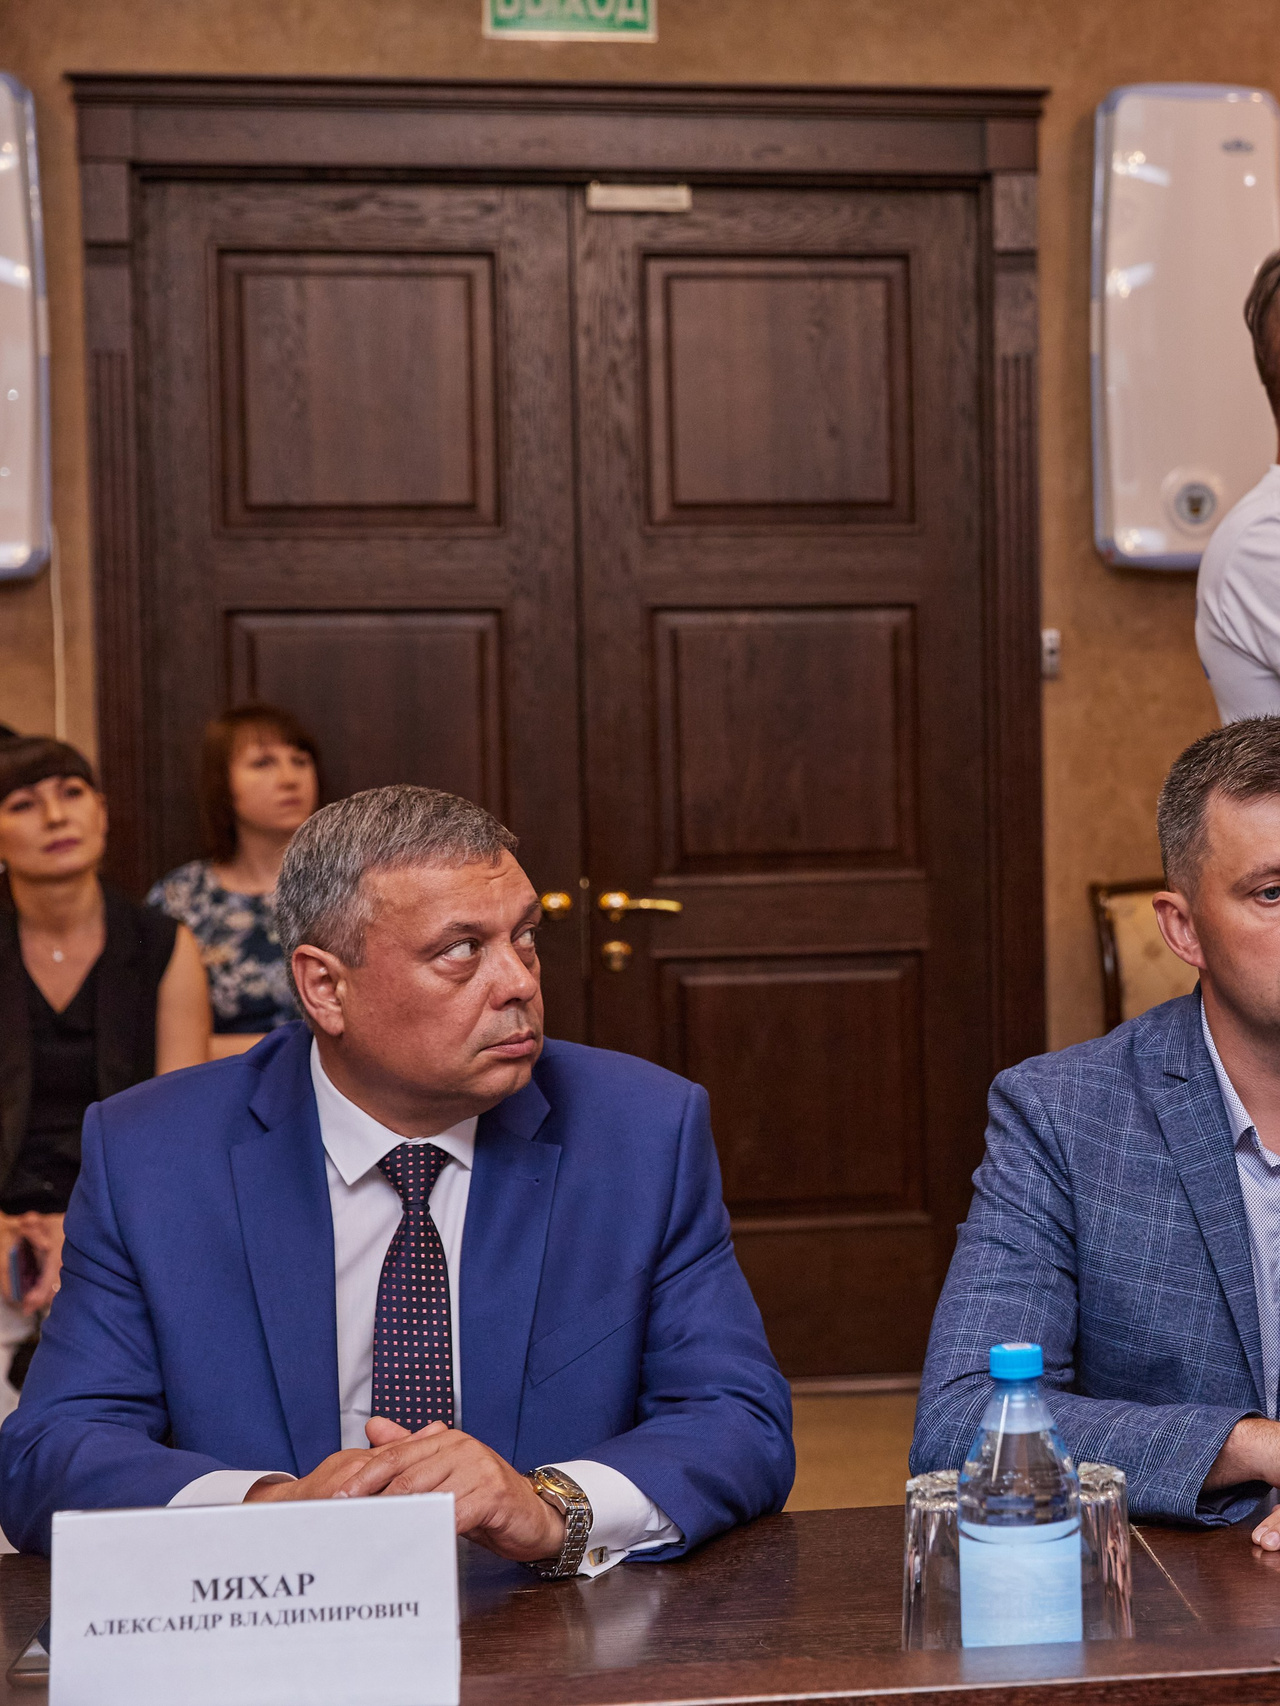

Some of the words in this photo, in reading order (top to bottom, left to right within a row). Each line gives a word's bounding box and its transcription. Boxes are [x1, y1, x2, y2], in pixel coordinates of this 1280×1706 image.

[191, 1573, 316, 1602] МЯХАР
[84, 1613, 223, 1637] АЛЕКСАНДР
[230, 1602, 420, 1629] ВЛАДИМИРОВИЧ
